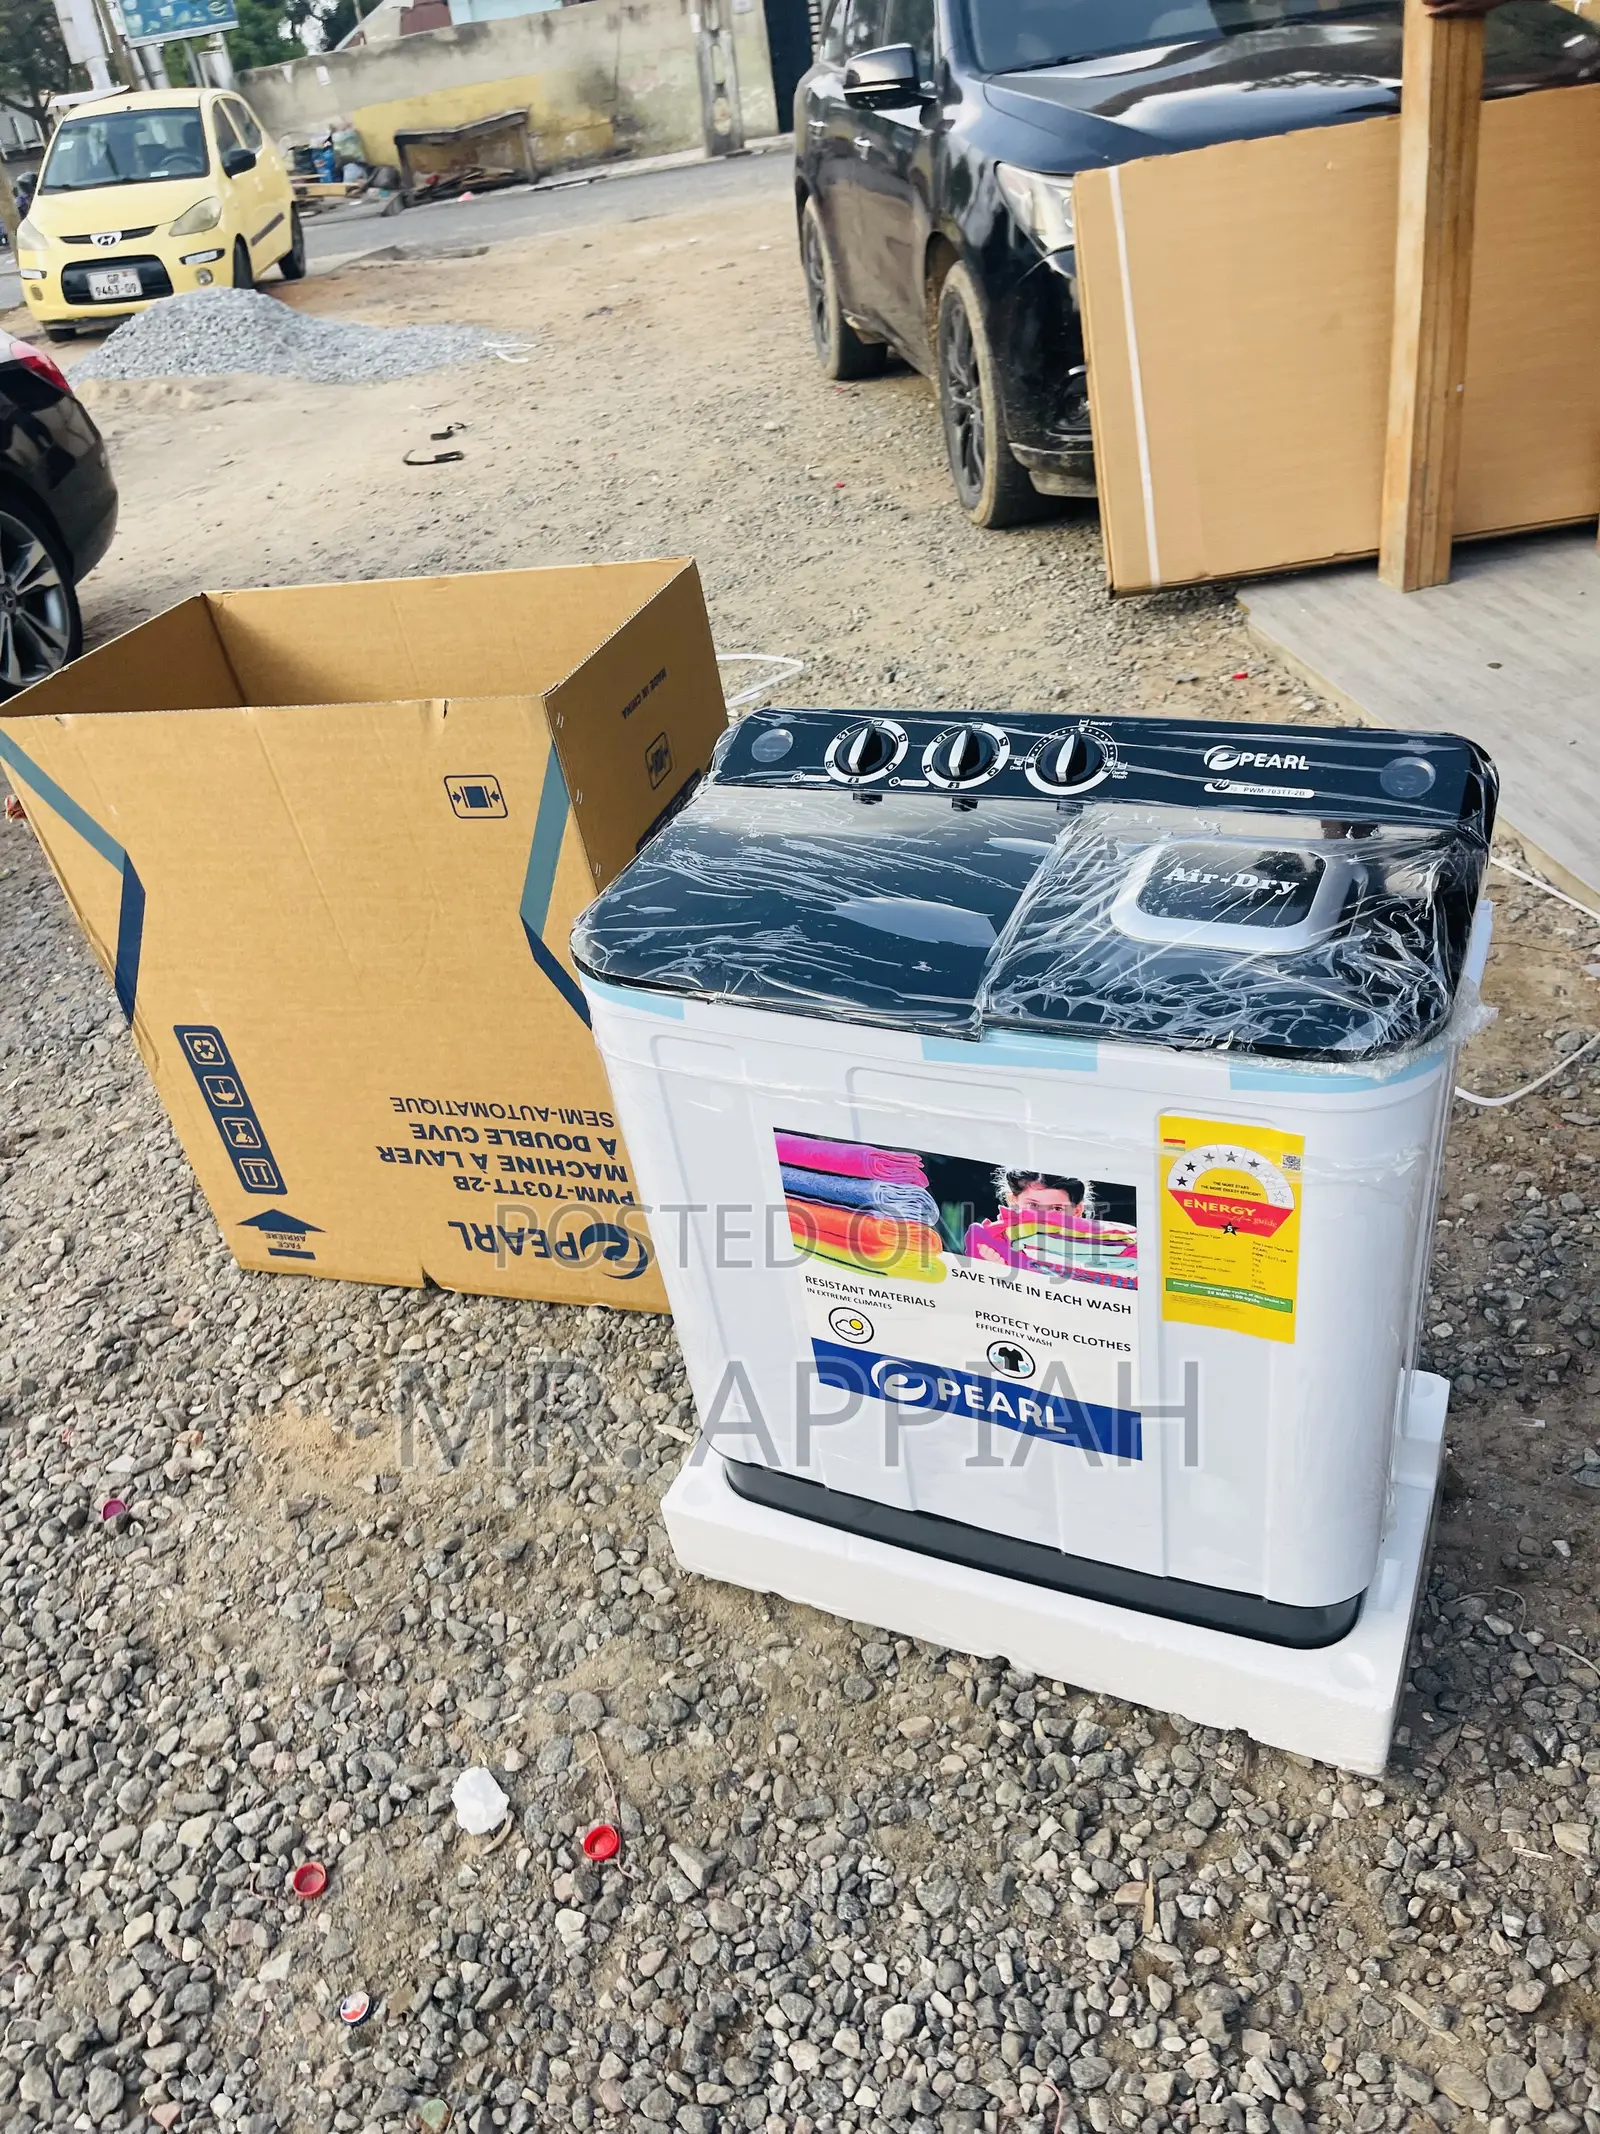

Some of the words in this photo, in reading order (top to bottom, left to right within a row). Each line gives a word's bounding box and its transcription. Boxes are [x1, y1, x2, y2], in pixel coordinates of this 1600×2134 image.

[1238, 752, 1310, 770] PEARL
[1162, 867, 1300, 896] Air-Dry
[389, 1097, 615, 1128] SEMI-AUTOMATIQUE
[408, 1122, 480, 1144] CUVE
[483, 1127, 592, 1153] DOUBLE
[375, 1145, 465, 1169] LAVER
[597, 1137, 617, 1160] À
[469, 1152, 489, 1175] À
[496, 1154, 629, 1183] MACHINE
[452, 1175, 636, 1207] PWM-703TT-2B
[1183, 1198, 1256, 1217] ENERGY
[277, 1241, 302, 1250] FACE
[447, 1220, 580, 1261] PEARL
[805, 1275, 865, 1295] RESISTANT
[868, 1288, 936, 1308] MATERIALS
[816, 1289, 852, 1303] EXTREME
[853, 1297, 893, 1310] CLIMATES
[951, 1268, 985, 1283] SAVE
[989, 1276, 1022, 1292] TIME
[1026, 1286, 1041, 1298] IN
[1045, 1291, 1082, 1306] EACH
[1086, 1299, 1132, 1314] WASH
[975, 1310, 1030, 1331] PROTECT
[1032, 1325, 1069, 1341] YOUR
[1073, 1335, 1131, 1352] CLOTHES
[976, 1323, 1025, 1339] EFFICIENTLY
[1026, 1335, 1053, 1347] WASH
[936, 1377, 1066, 1434] PEARL
